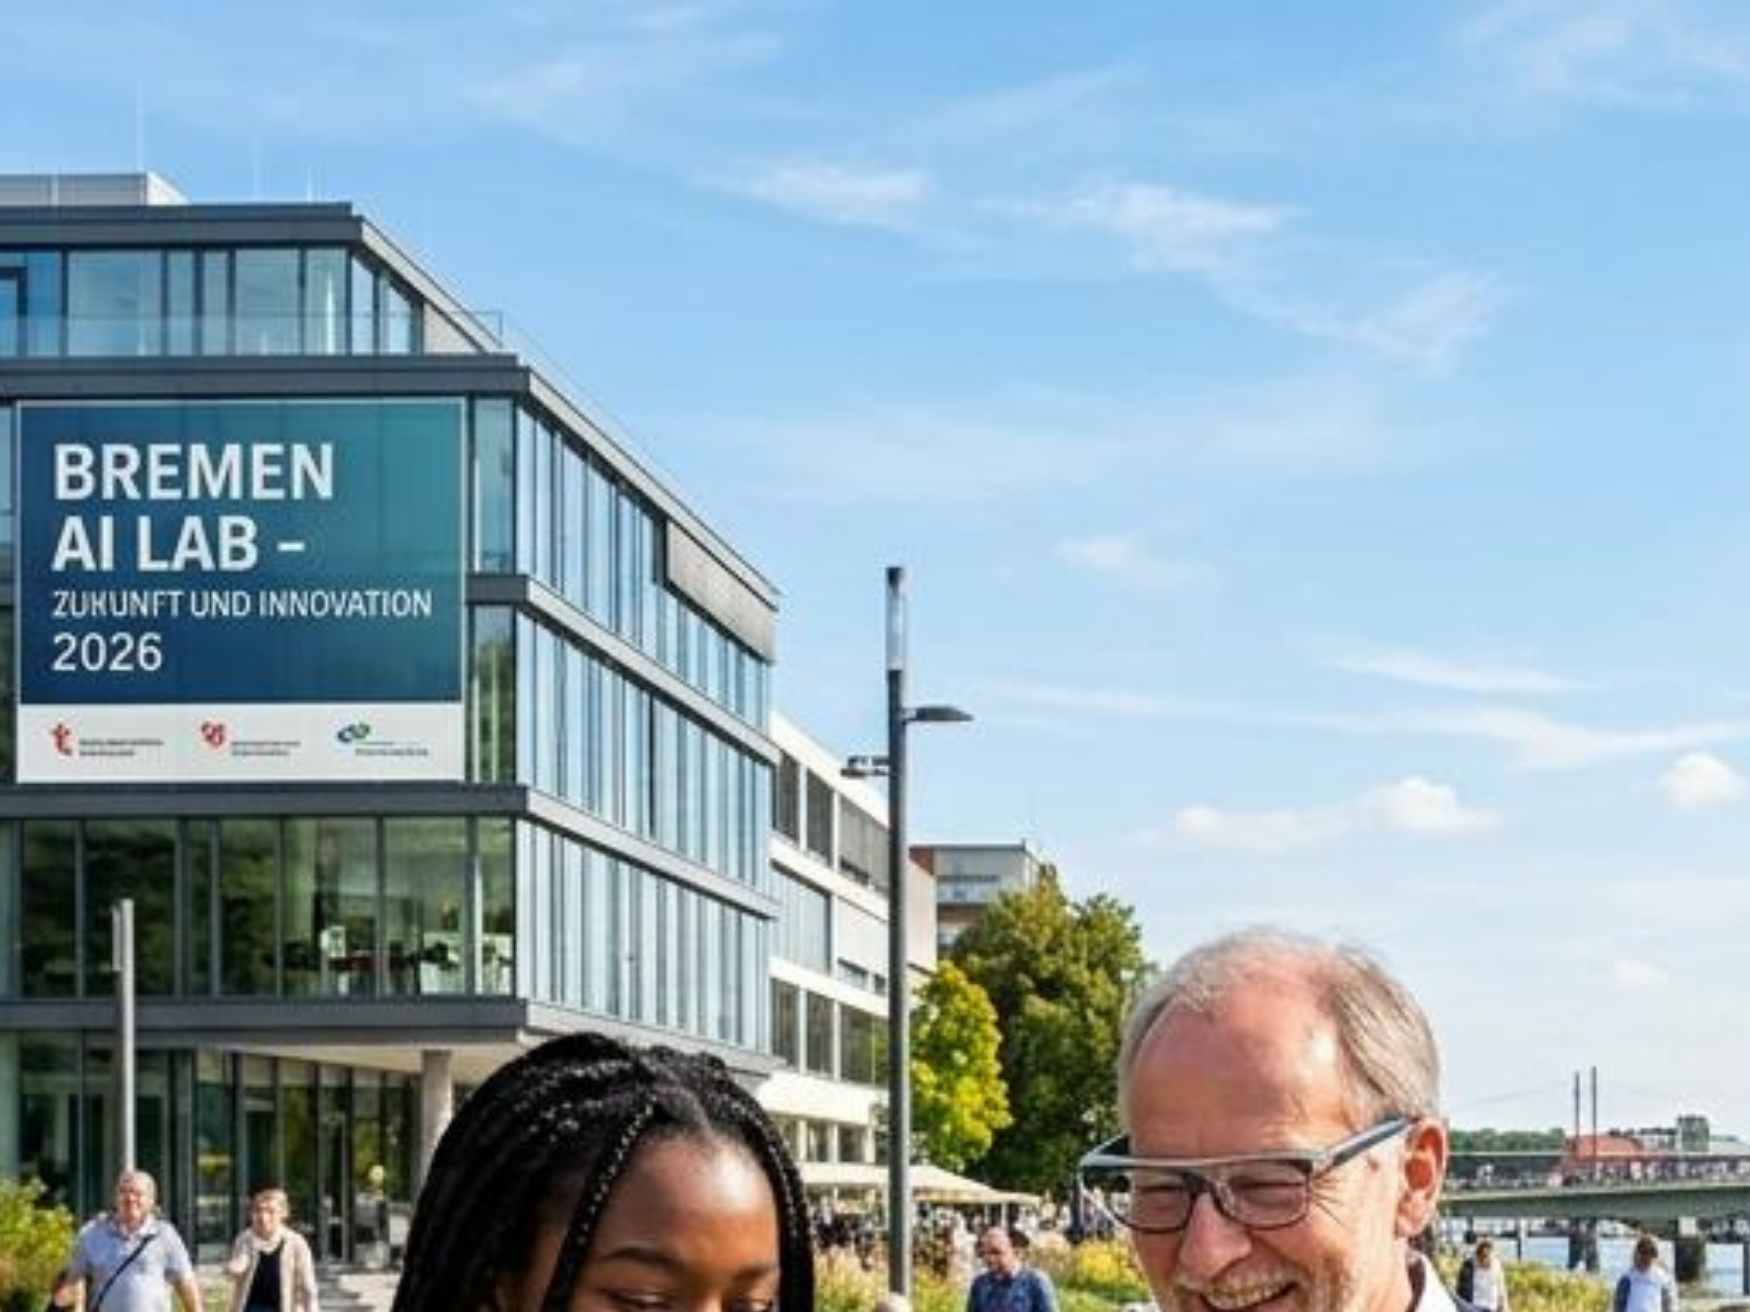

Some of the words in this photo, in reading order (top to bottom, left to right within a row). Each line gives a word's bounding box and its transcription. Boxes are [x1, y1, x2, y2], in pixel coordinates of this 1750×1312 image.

[53, 442, 334, 500] BREMEN
[52, 515, 115, 572] AI
[137, 515, 259, 572] LAB
[190, 590, 252, 618] UND
[260, 590, 432, 618] INNOVATION
[53, 632, 162, 671] 2026
